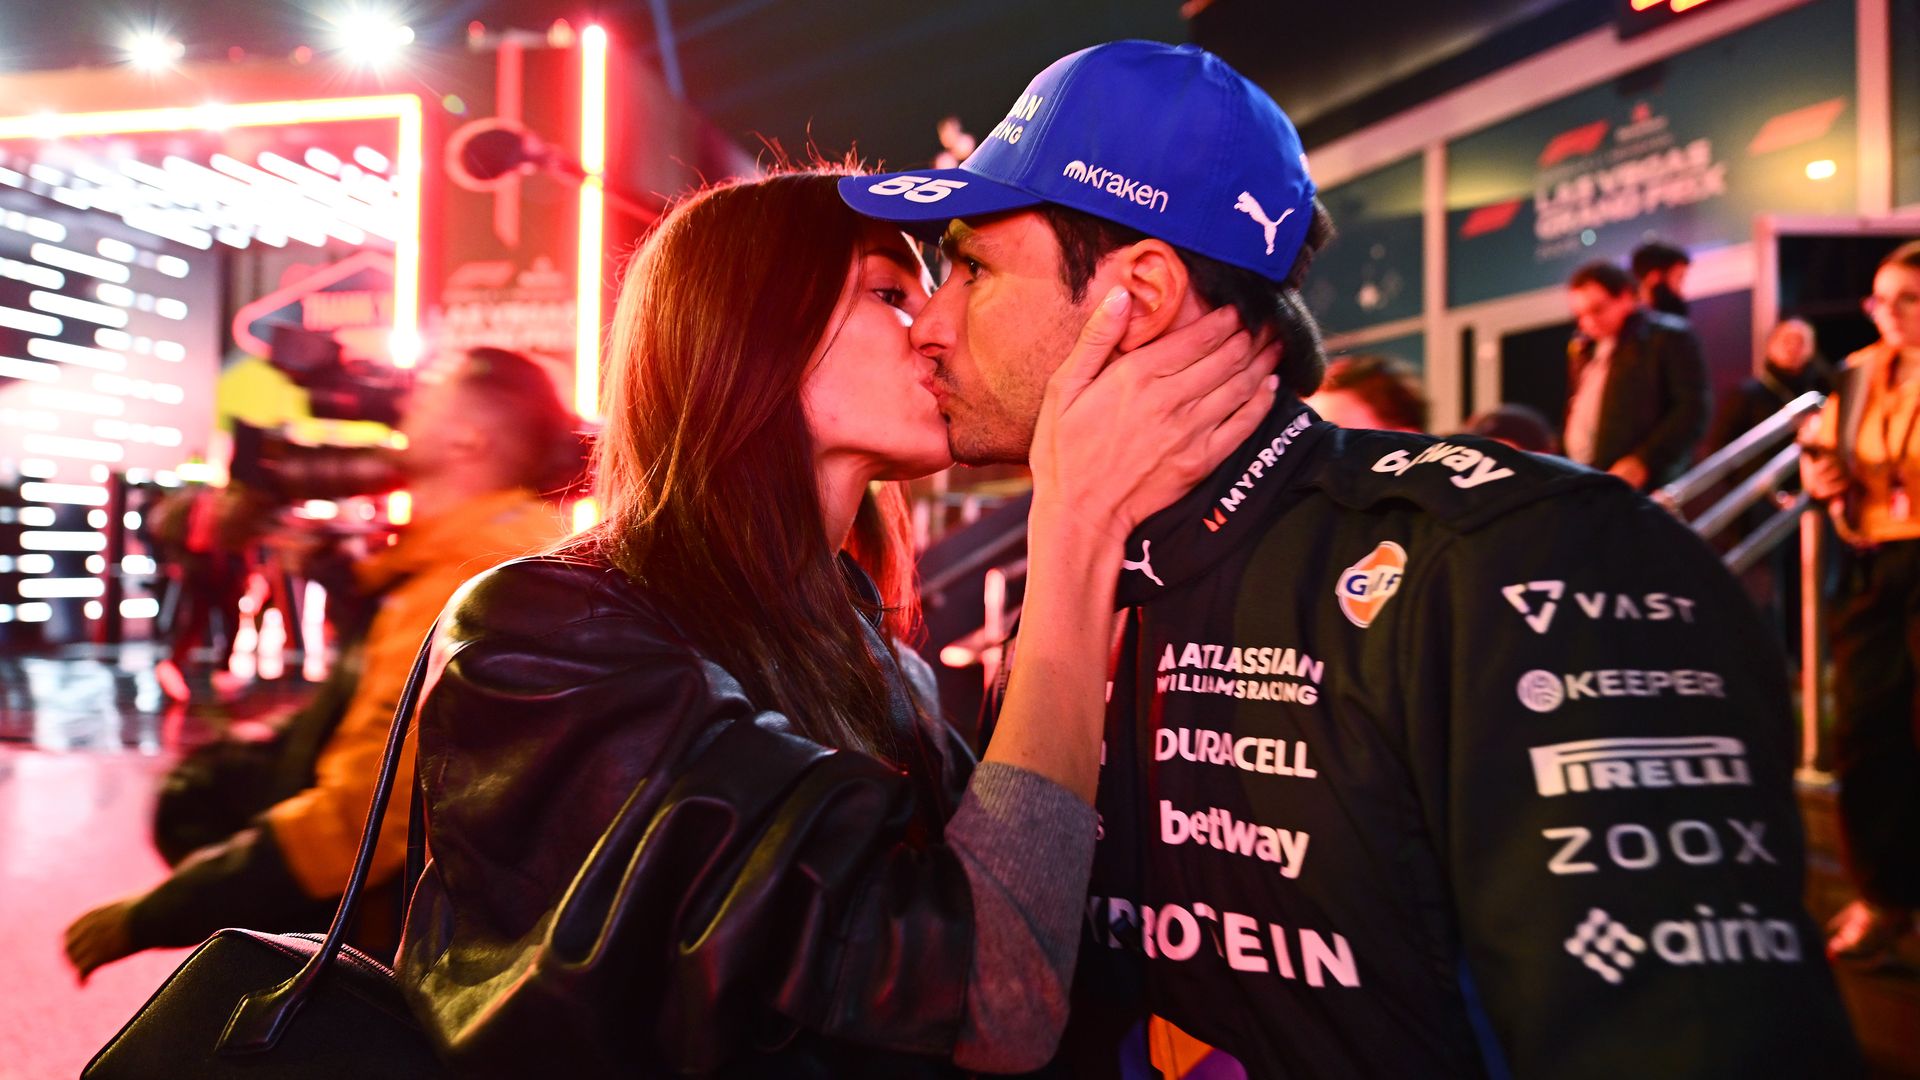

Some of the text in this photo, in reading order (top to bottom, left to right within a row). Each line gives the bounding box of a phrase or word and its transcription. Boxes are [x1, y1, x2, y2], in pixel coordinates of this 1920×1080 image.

[867, 175, 968, 204] 55
[1084, 164, 1169, 213] kraken
[1574, 592, 1696, 622] VAST
[1177, 642, 1324, 686] ATLASSIAN
[1564, 669, 1726, 700] KEEPER
[1155, 727, 1318, 779] DURACELL
[1528, 736, 1752, 798] PIRELLI
[1160, 799, 1310, 879] betway
[1541, 819, 1778, 875] ZOOX
[1652, 903, 1801, 966] airia
